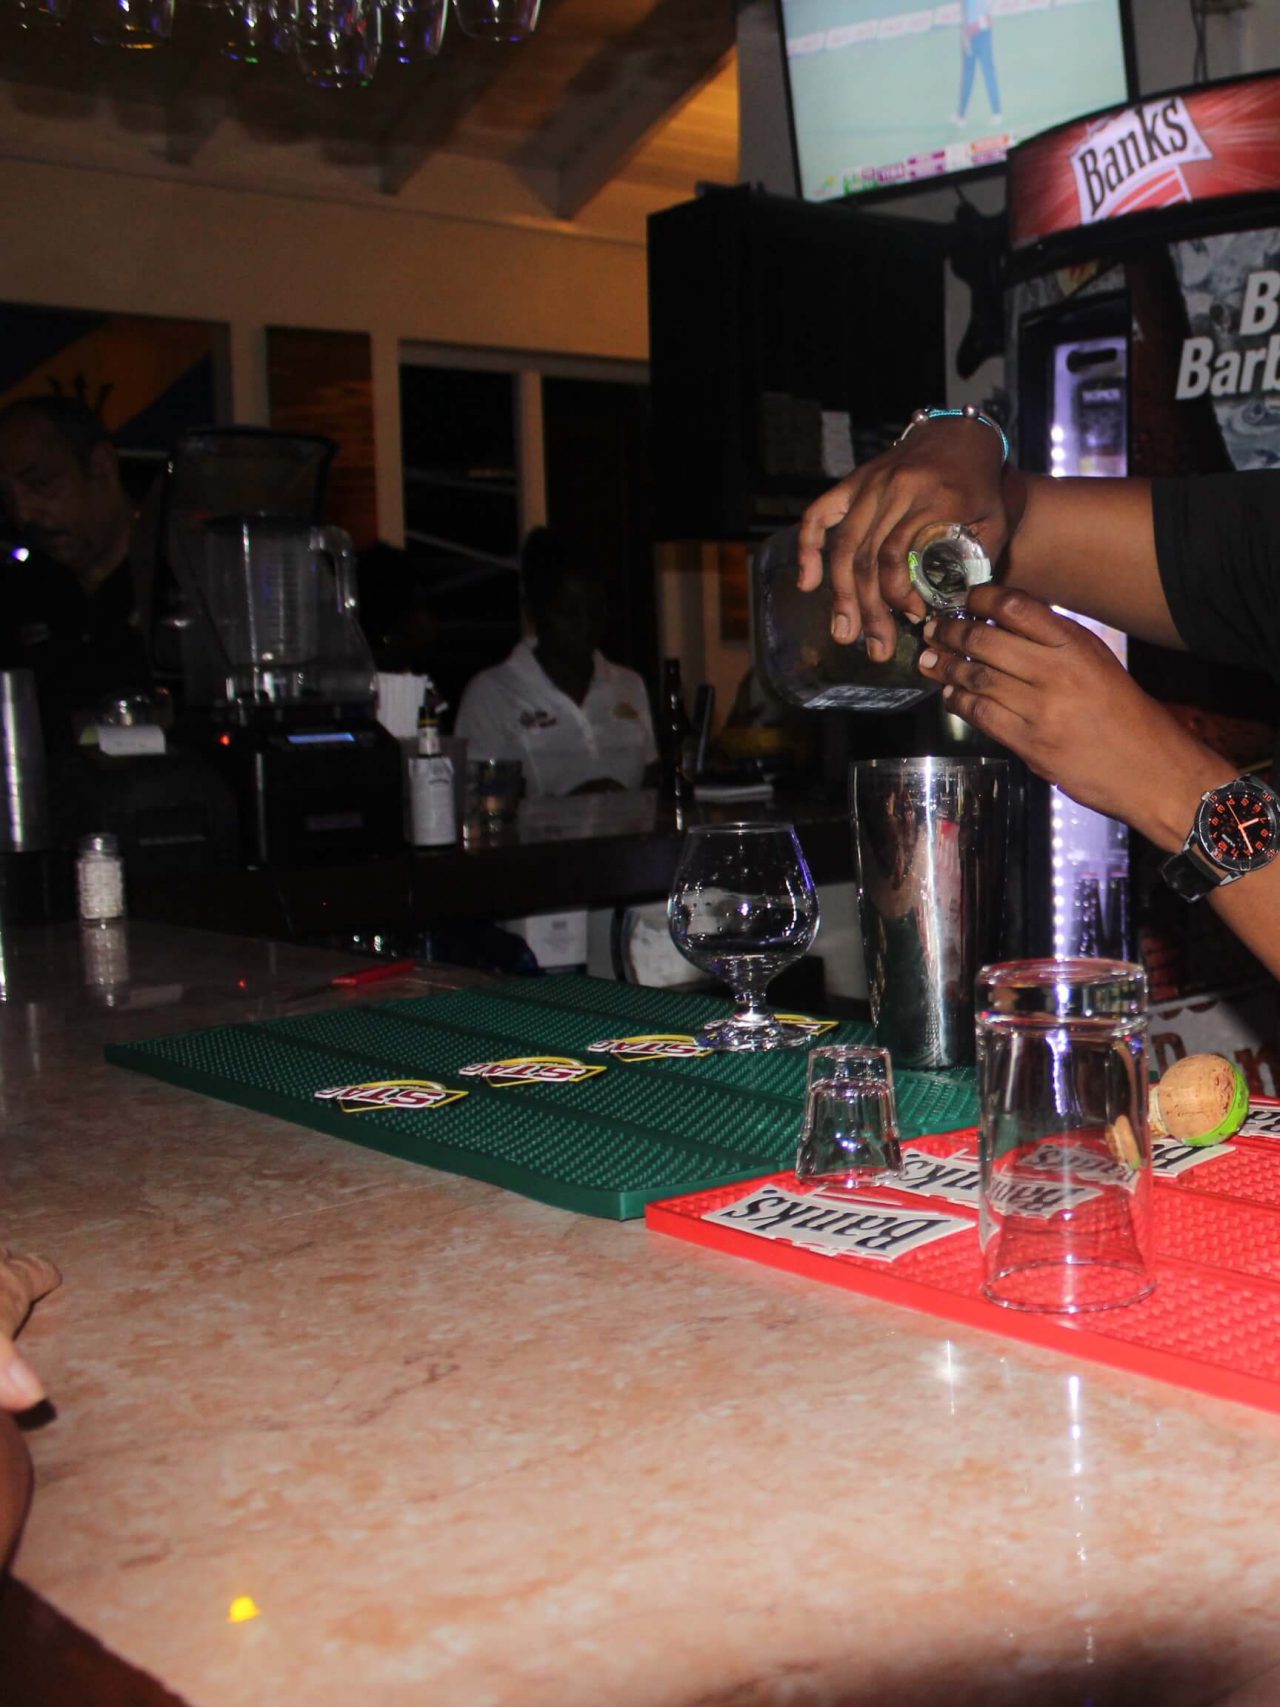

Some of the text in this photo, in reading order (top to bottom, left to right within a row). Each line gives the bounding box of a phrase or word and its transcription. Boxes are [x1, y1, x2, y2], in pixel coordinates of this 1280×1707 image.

[1079, 99, 1188, 216] Banks
[587, 1040, 701, 1057] STAG
[459, 1062, 587, 1082] STAG
[314, 1085, 446, 1108] STAG
[721, 1195, 952, 1251] Banks
